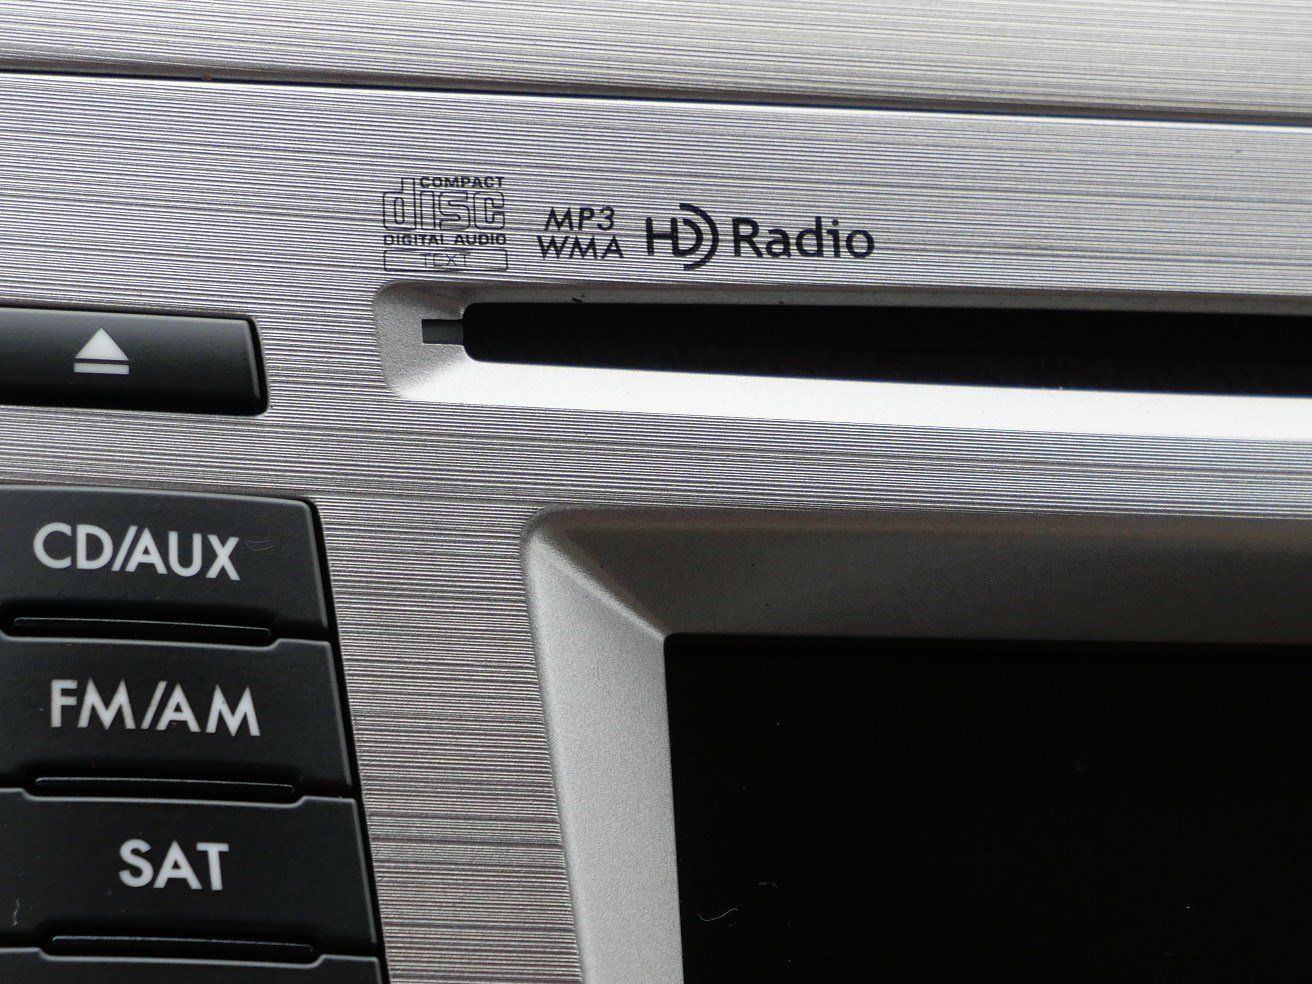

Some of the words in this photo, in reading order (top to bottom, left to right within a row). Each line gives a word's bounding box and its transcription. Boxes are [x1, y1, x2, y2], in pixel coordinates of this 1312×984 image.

[383, 233, 447, 246] DIGITAL
[453, 234, 506, 246] AUDIO
[543, 205, 616, 232] MP3
[646, 203, 719, 271] HD
[733, 216, 875, 259] Radio
[536, 234, 625, 260] WMA
[32, 522, 241, 582] CD/AUX
[50, 678, 261, 737] FM/AM
[119, 839, 230, 891] SAT
